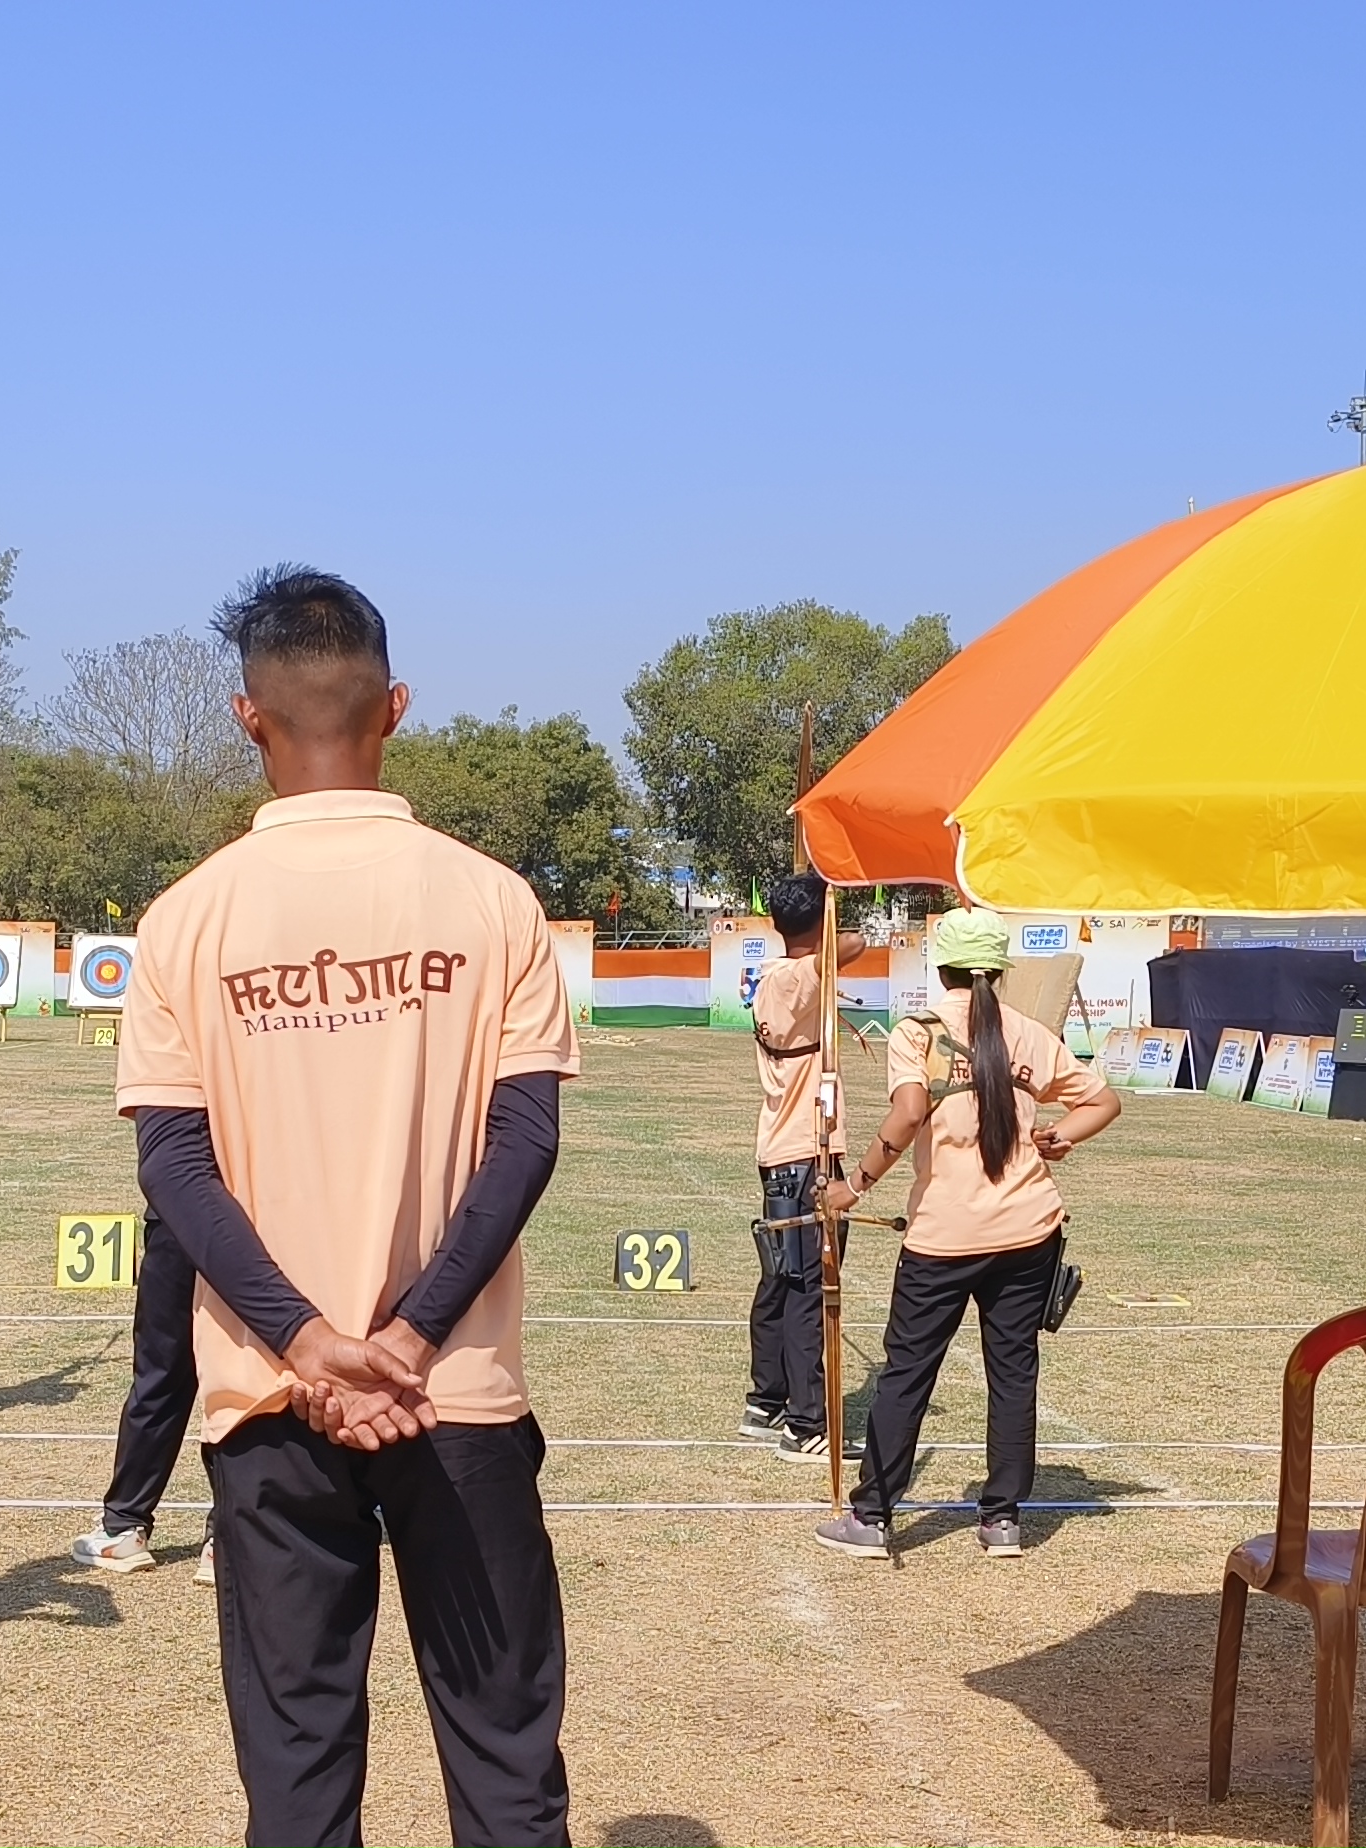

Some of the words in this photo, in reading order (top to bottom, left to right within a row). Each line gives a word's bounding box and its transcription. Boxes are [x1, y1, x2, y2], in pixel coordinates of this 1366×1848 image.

[1306, 939, 1336, 947] WEST
[1097, 998, 1128, 1008] (M&W)
[1069, 1009, 1106, 1017] ONSHIP
[241, 1005, 390, 1037] Manipur
[97, 1029, 113, 1044] 29
[66, 1221, 122, 1283] 31
[623, 1233, 684, 1291] 32
